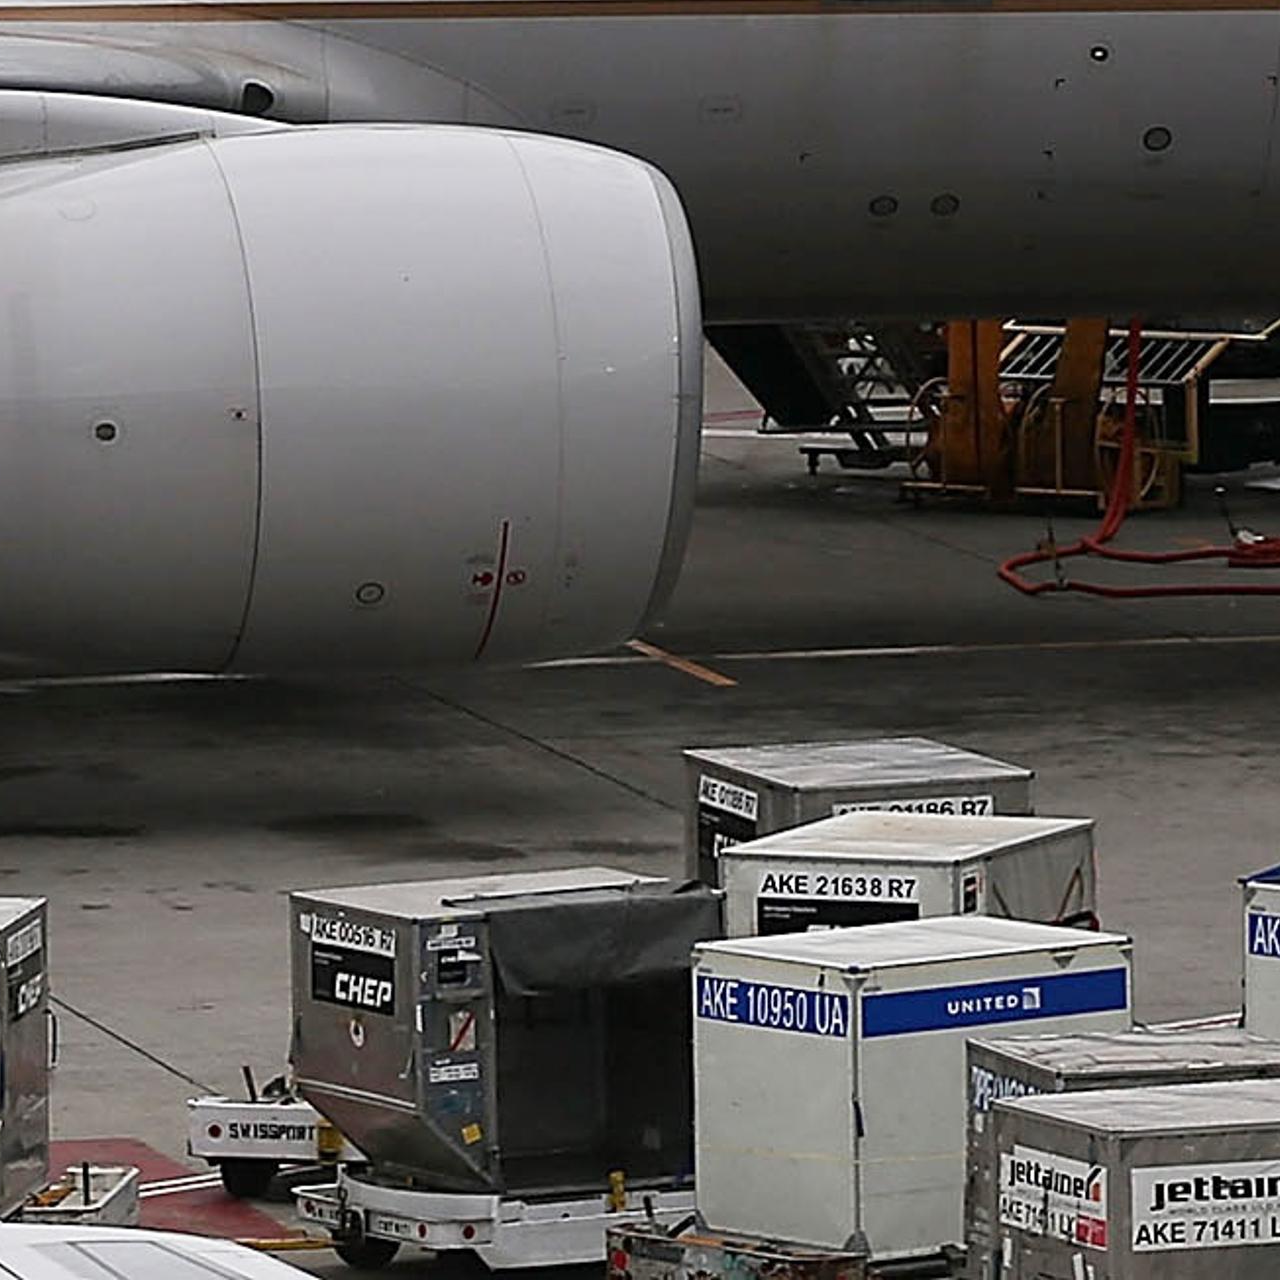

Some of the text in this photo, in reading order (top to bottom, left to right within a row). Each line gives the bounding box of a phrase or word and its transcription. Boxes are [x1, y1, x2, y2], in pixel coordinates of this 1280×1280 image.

[761, 873, 916, 898] AKE 21638 R7
[335, 972, 392, 1008] CHEP
[947, 995, 1018, 1015] UNITED
[700, 978, 845, 1035] AKE 10950 UA
[1008, 1159, 1102, 1200] jettainer
[1135, 1221, 1187, 1246] AKE
[1192, 1217, 1260, 1241] 71411
